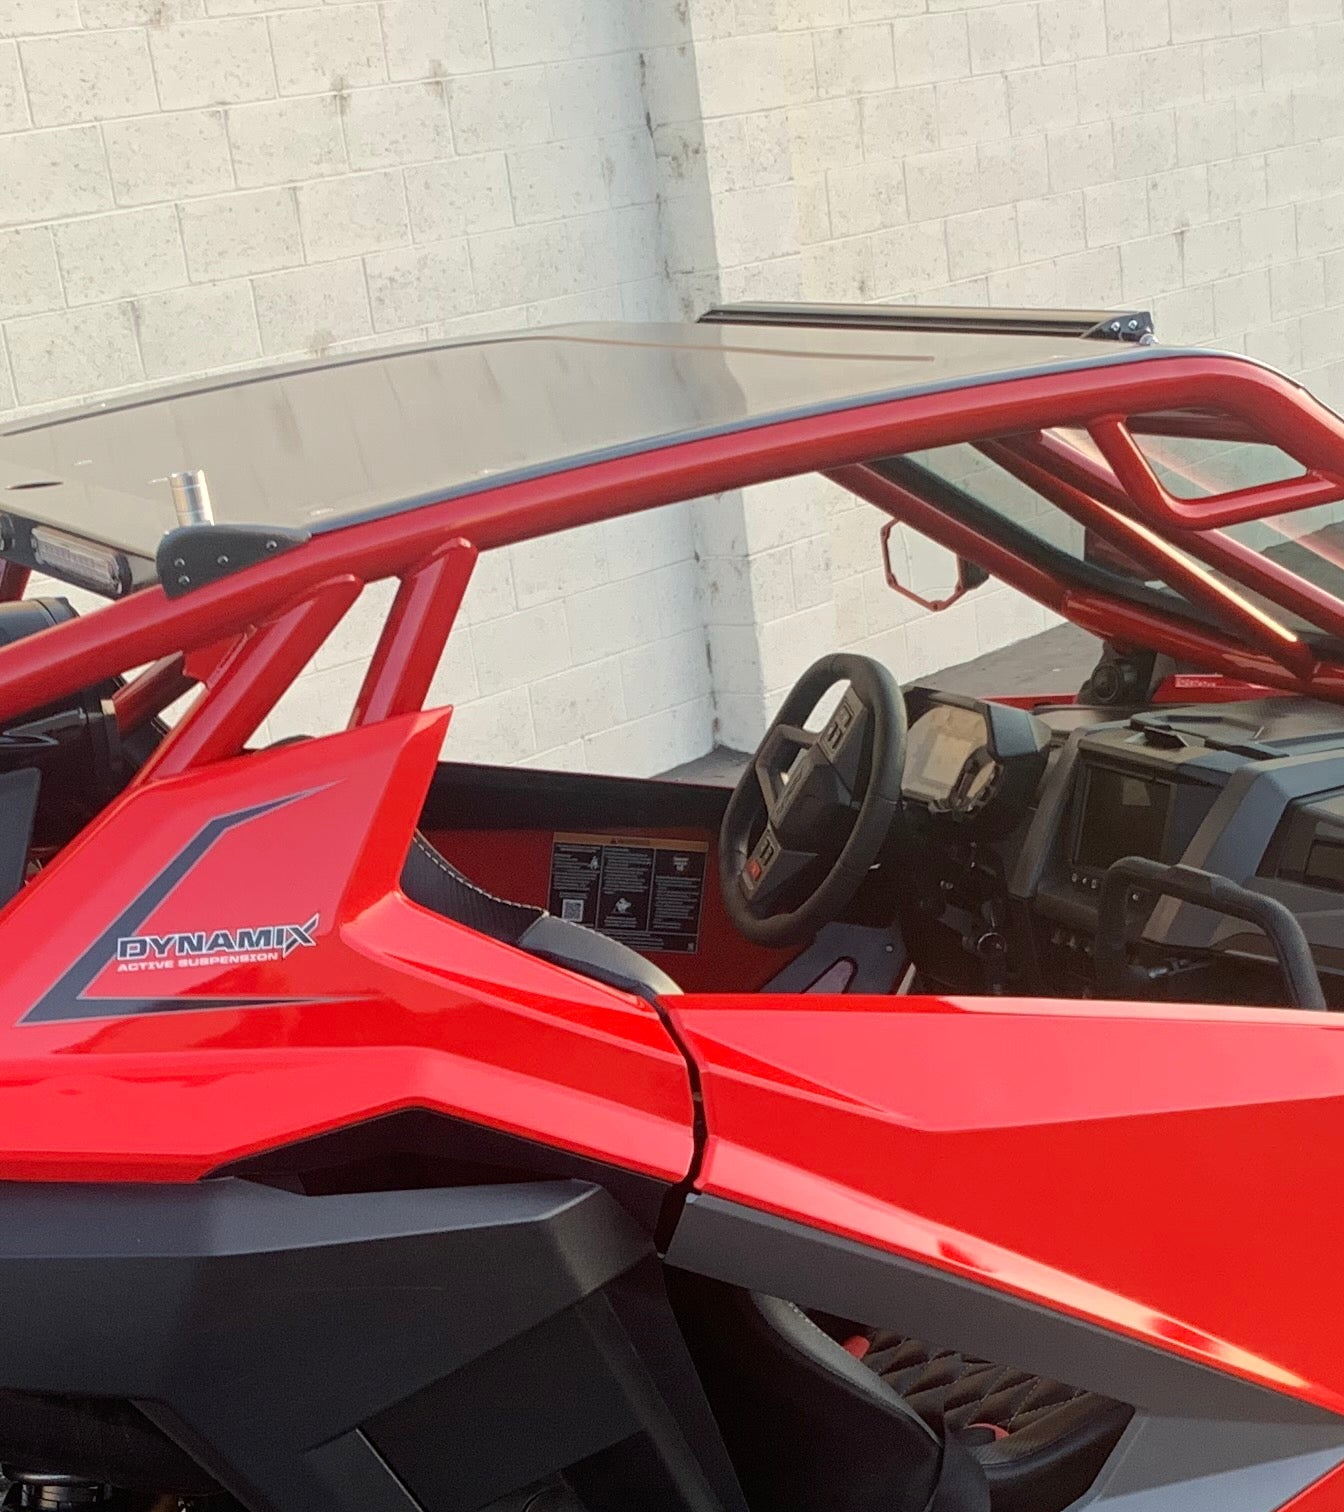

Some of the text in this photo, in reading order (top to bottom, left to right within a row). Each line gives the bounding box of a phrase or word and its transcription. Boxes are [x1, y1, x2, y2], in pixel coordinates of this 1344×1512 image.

[117, 913, 320, 959] DYNAMIX
[117, 952, 278, 973] ACTIVE SUSPENSION
